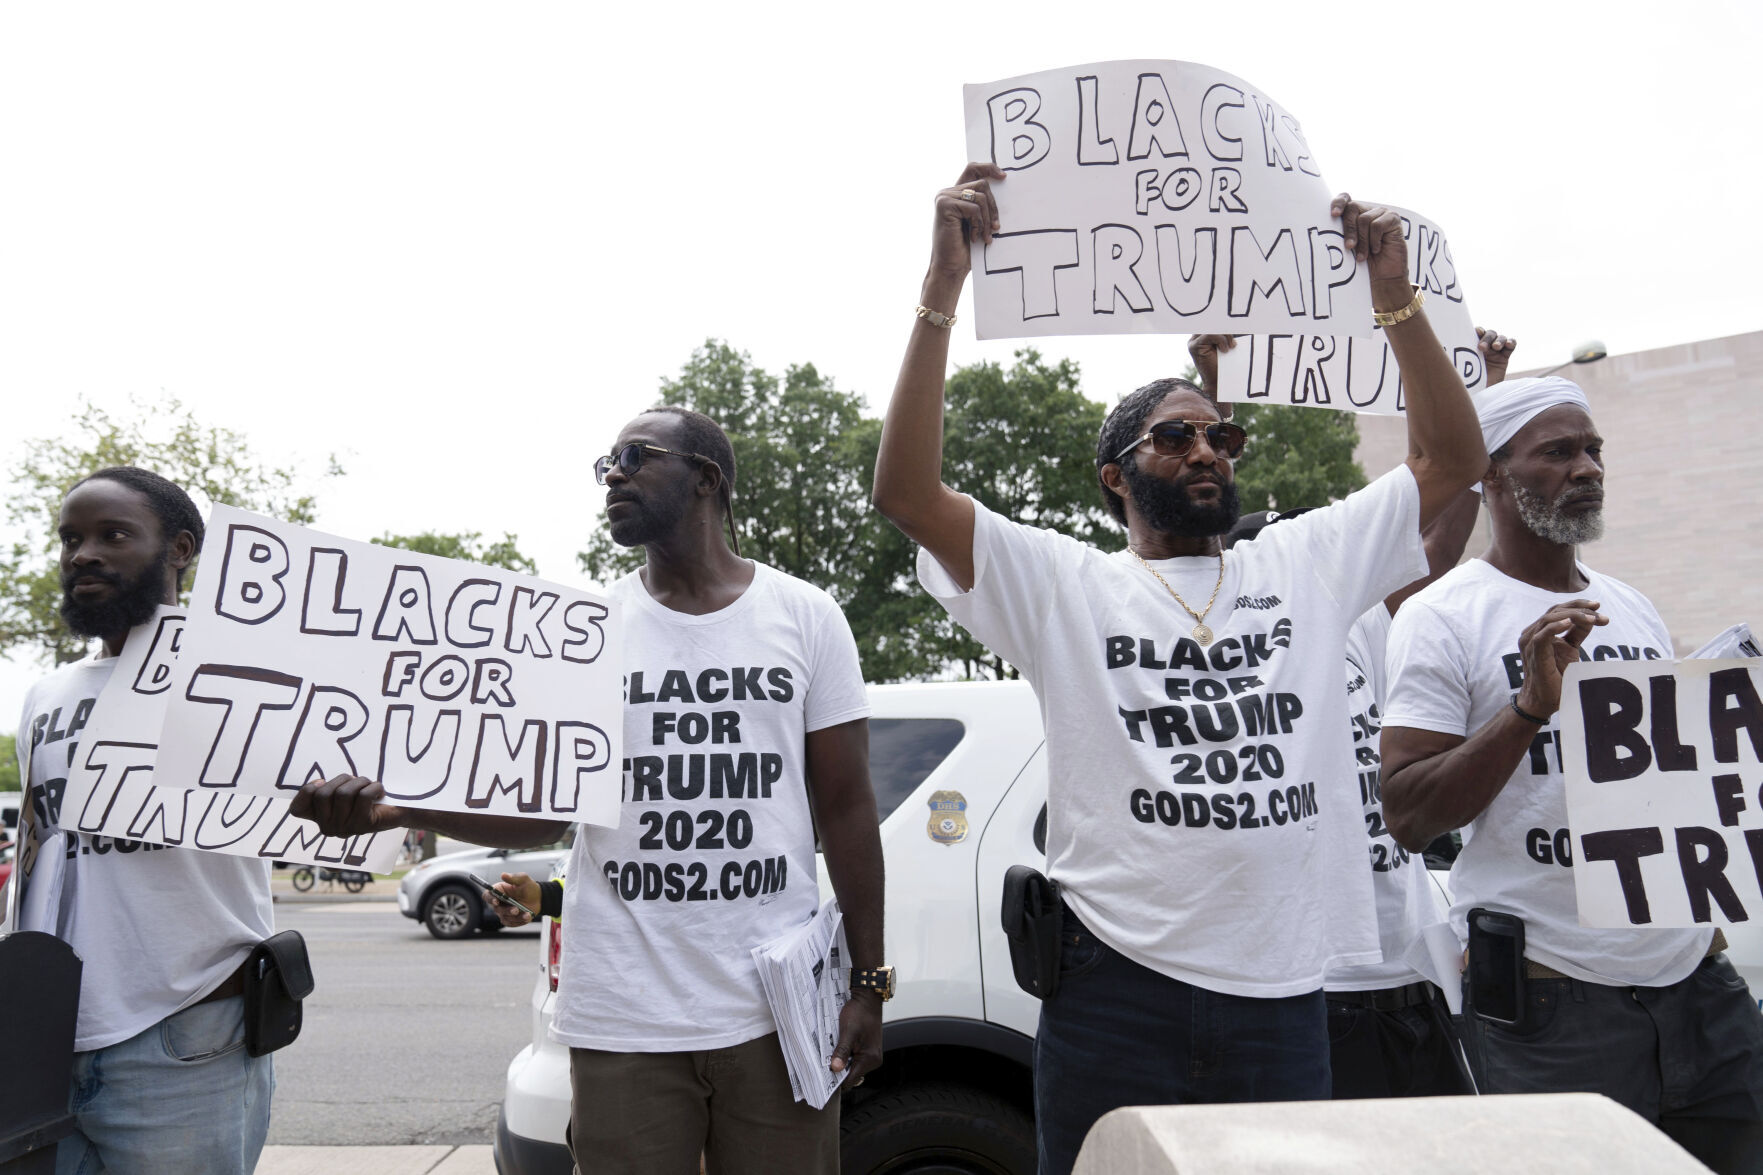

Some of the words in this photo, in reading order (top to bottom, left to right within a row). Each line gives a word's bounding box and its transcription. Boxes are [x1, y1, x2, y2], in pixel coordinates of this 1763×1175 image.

[986, 73, 1321, 178] BLACKS
[1136, 167, 1248, 215] FOR
[984, 223, 1357, 321] TRUMP
[1235, 334, 1482, 411] TRUP
[215, 524, 609, 664] BLACKS
[1106, 618, 1292, 672] BLACKS
[382, 651, 515, 708] FOR
[623, 667, 794, 704] LACKS
[1165, 675, 1265, 701] FOR
[186, 663, 611, 813] TRUMP
[652, 710, 741, 745] FOR
[1118, 692, 1303, 748] TRUMP
[1170, 743, 1284, 785] 2020
[639, 809, 753, 851] 2020
[1130, 781, 1319, 831] GODS2.COM
[603, 854, 788, 902] GODS2.COM
